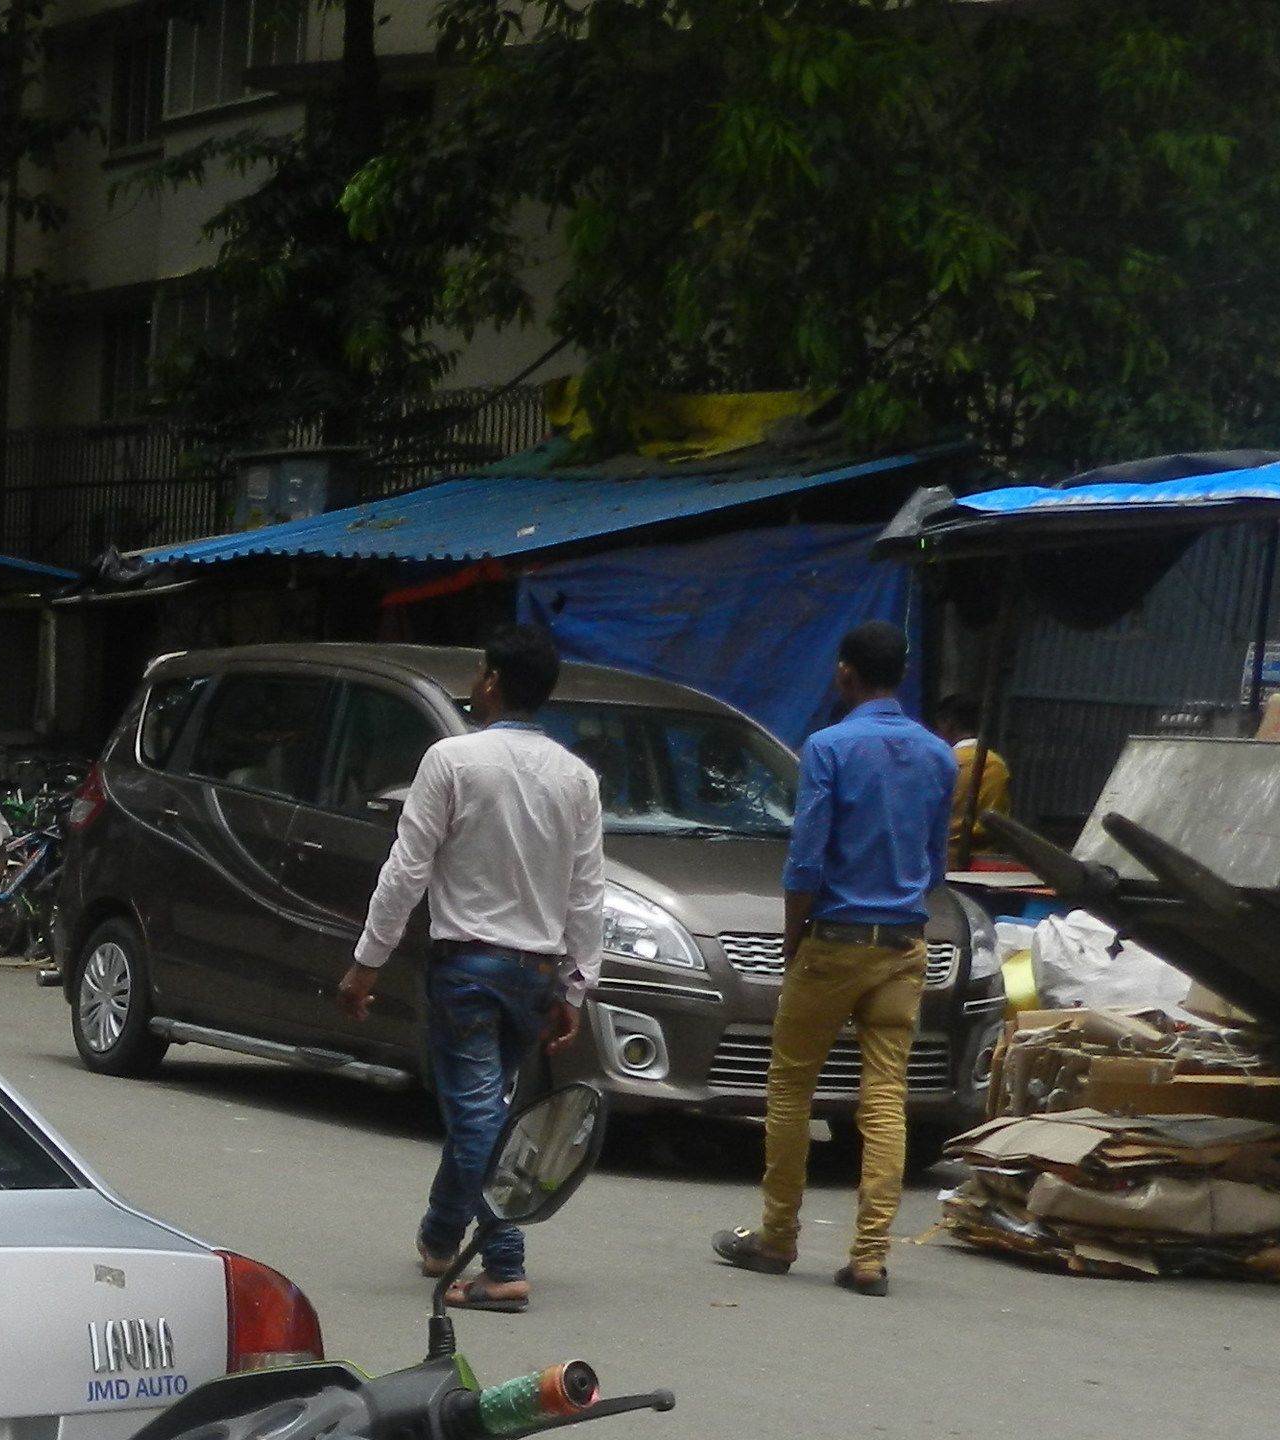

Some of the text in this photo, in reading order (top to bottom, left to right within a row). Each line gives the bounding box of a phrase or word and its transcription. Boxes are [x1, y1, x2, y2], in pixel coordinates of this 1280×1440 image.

[88, 1316, 175, 1373] LAURA
[87, 1374, 189, 1402] JMD AUTO
